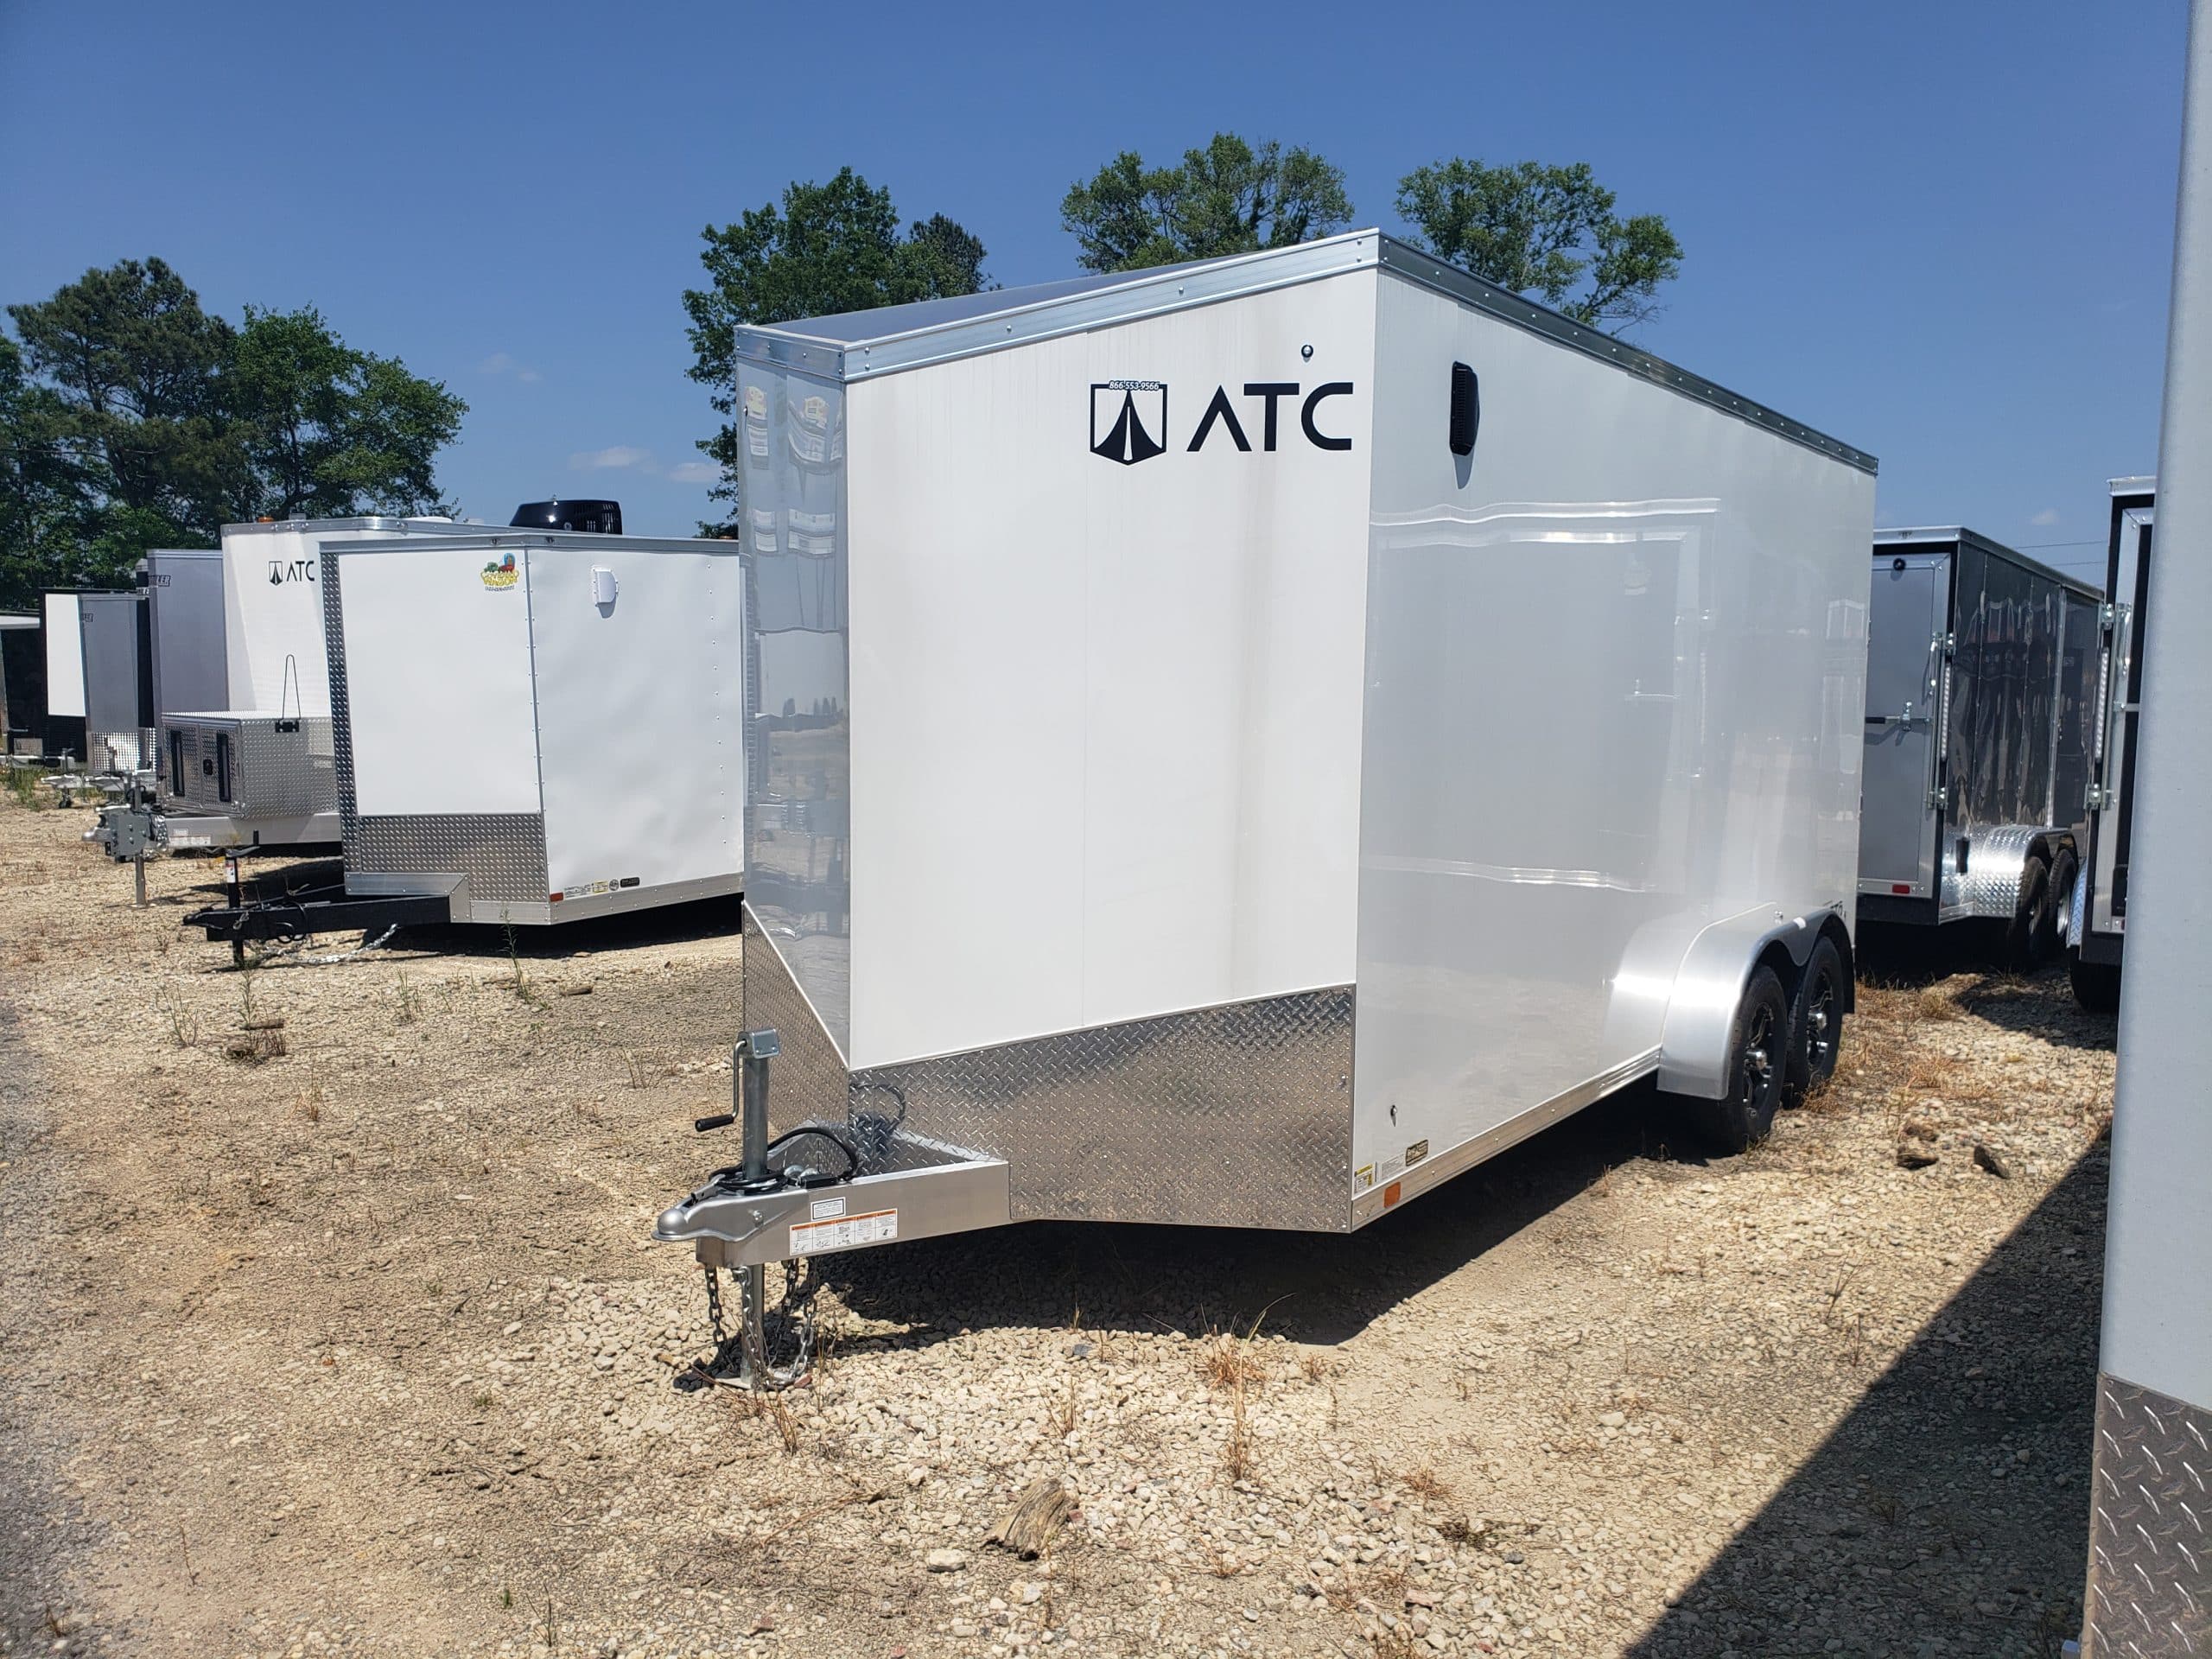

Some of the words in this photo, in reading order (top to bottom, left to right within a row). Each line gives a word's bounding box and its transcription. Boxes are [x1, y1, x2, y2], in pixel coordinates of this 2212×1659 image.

[1109, 380, 1160, 391] 866-553-9566
[1186, 382, 1353, 452] ATC
[286, 560, 315, 582] ATC
